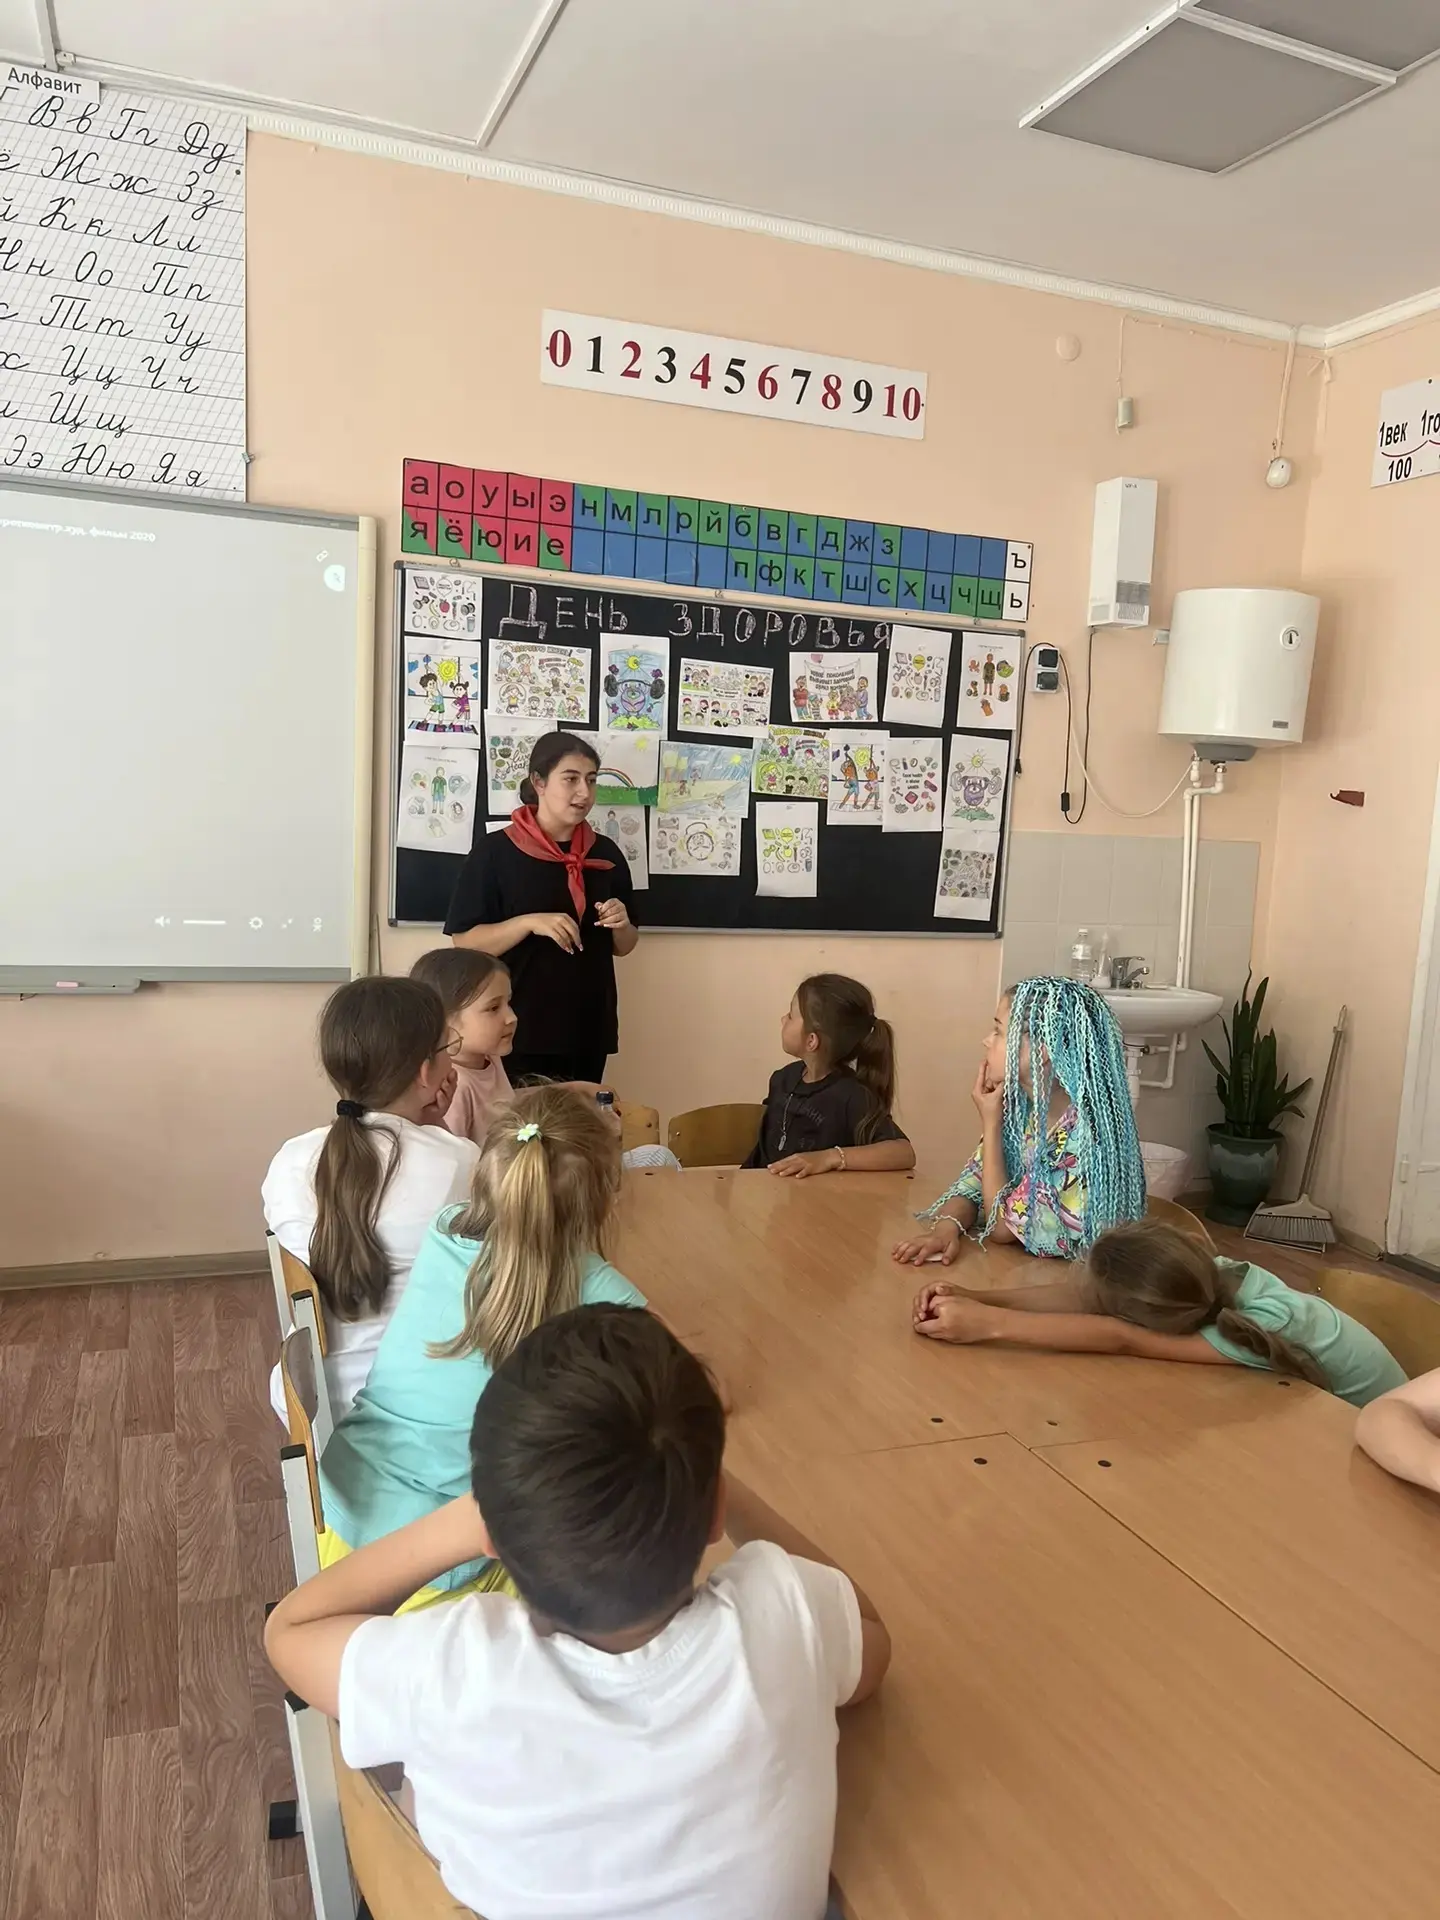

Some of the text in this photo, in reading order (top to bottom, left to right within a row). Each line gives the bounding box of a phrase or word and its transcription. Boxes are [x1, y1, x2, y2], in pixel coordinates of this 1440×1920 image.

[8, 67, 82, 95] Алфавит
[549, 329, 921, 422] 0 1 2 3 4 5 6 7 8 9 10
[1388, 456, 1412, 482] 100
[411, 475, 429, 495] а
[446, 480, 465, 498] о
[482, 485, 499, 508] у
[512, 492, 534, 509] ы
[549, 494, 566, 512] э
[582, 499, 597, 516] н
[612, 503, 631, 522] м
[643, 507, 661, 525] л
[677, 510, 692, 530] р
[706, 511, 722, 534] й
[735, 515, 751, 537] б
[767, 524, 781, 540] в
[822, 532, 839, 550] д
[849, 534, 870, 552] ж
[1011, 553, 1026, 568] ъ
[410, 522, 428, 539] я
[445, 519, 464, 542] ё
[477, 530, 502, 548] ю
[514, 535, 531, 552] и
[547, 538, 564, 556] е
[734, 562, 748, 578] п
[759, 560, 782, 586] ф
[794, 568, 807, 585] к
[821, 571, 836, 588] т
[846, 574, 867, 592] ш
[903, 580, 918, 598] х
[932, 584, 945, 604] ц
[958, 586, 971, 602] ч
[1010, 592, 1022, 608] ь
[499, 584, 891, 649] ДЕНЬ ЗДОРОВЬЯ
